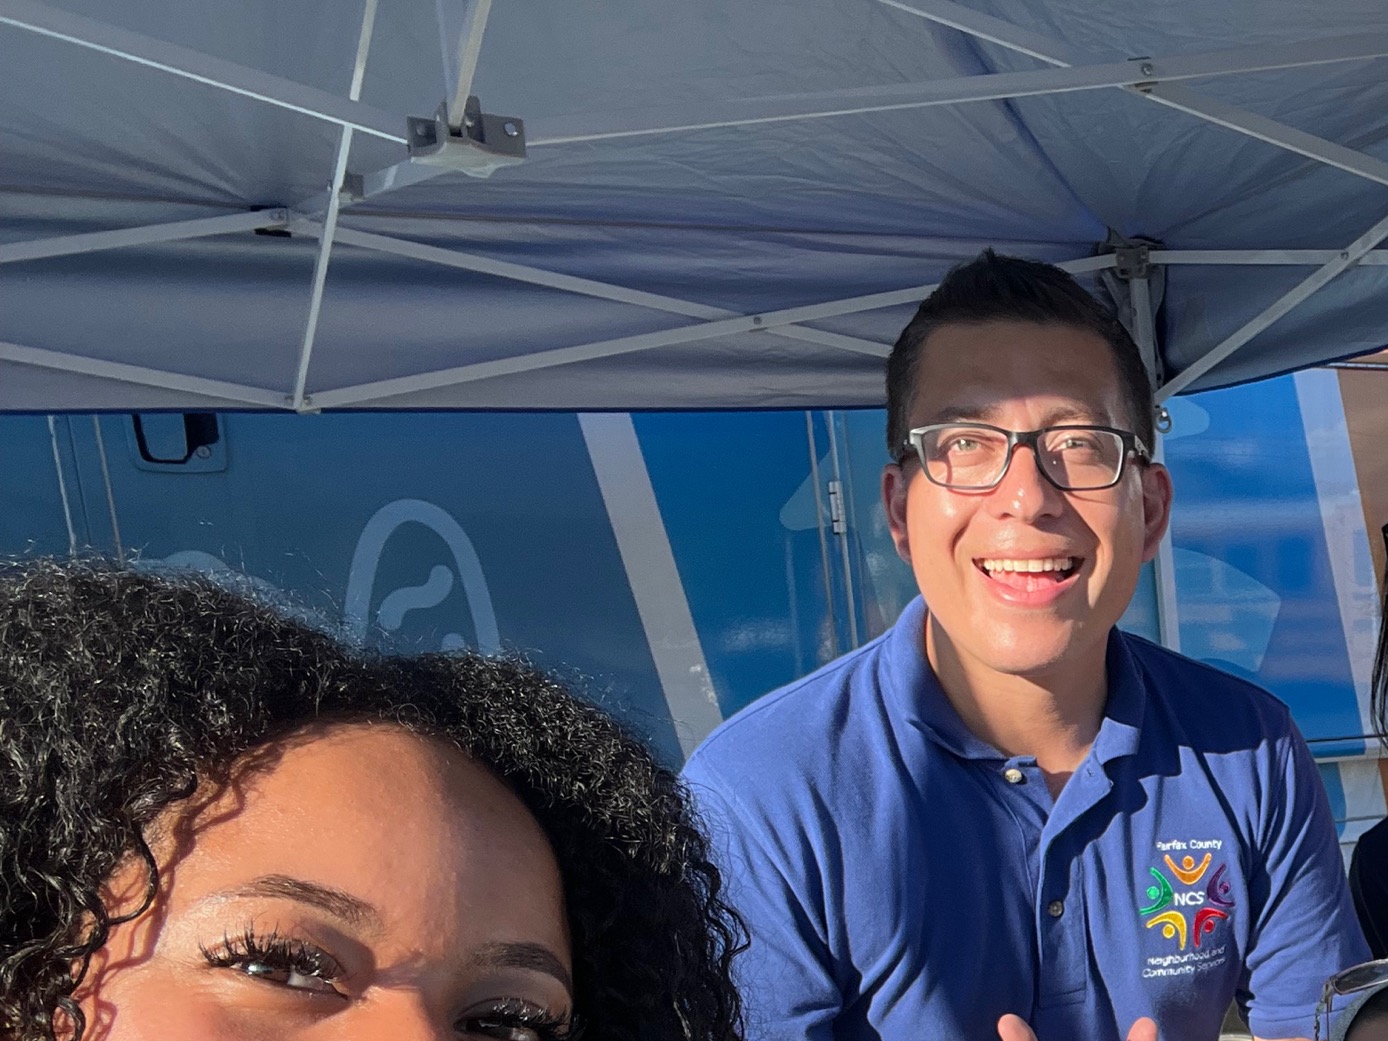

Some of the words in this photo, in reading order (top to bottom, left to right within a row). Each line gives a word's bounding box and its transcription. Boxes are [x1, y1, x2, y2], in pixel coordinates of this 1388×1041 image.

[1156, 840, 1187, 851] Fairfax
[1189, 839, 1223, 850] County
[1174, 891, 1205, 906] NCS
[1142, 965, 1196, 978] Community
